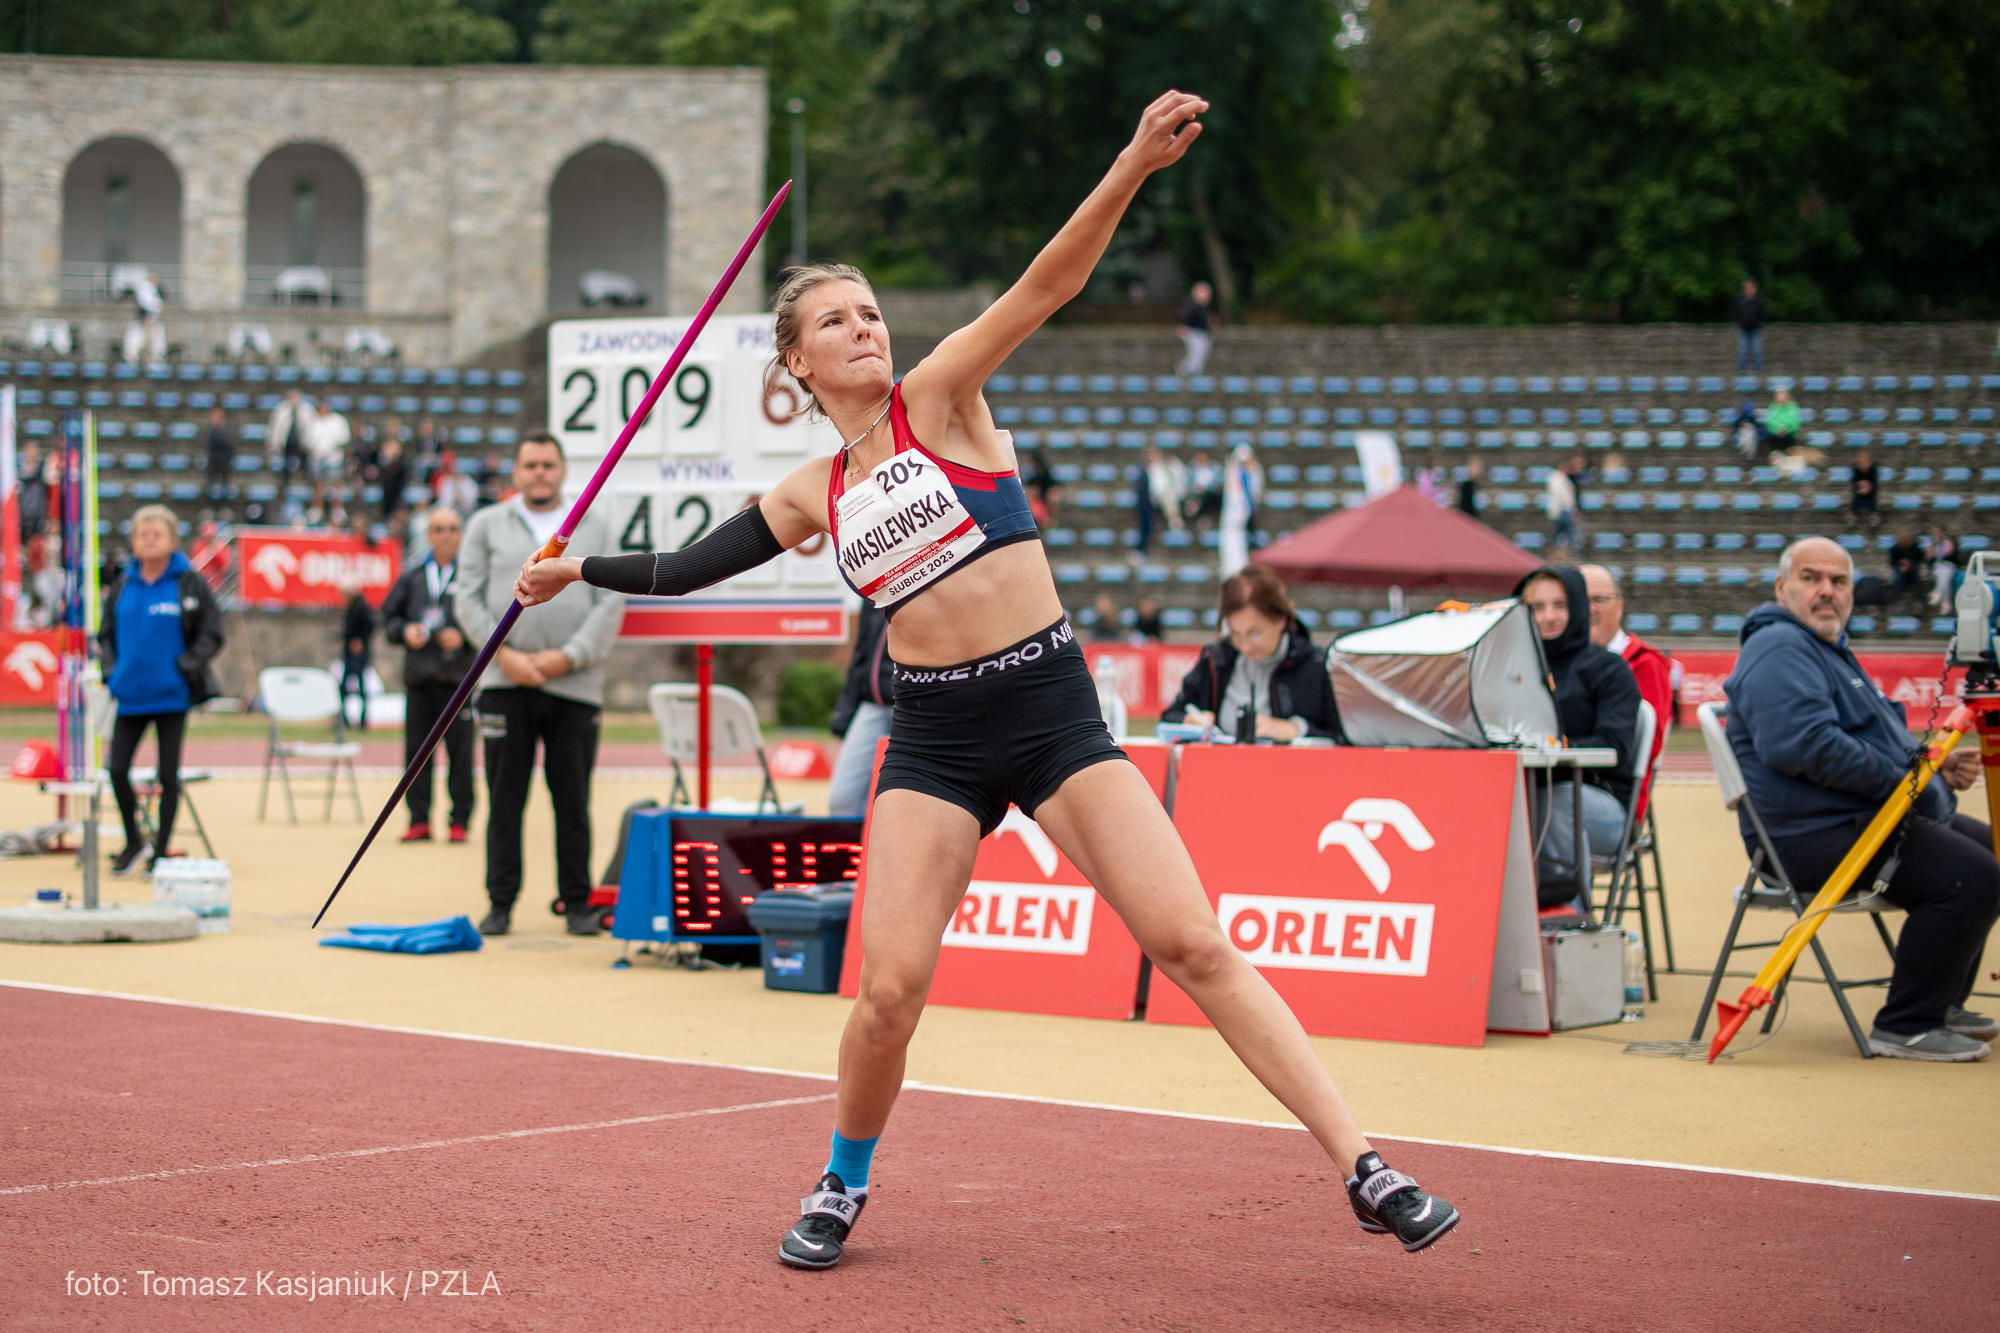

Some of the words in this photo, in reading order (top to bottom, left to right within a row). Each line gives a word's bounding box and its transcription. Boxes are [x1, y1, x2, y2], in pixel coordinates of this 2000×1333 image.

[563, 365, 712, 431] 209
[658, 461, 735, 481] WYNIK
[842, 490, 954, 572] WASILEWSKA
[889, 568, 928, 596] SŁUBICE
[927, 550, 955, 573] 2023
[901, 666, 972, 684] NIKE
[976, 642, 1043, 677] PRO
[953, 893, 1078, 941] RLEN
[1229, 908, 1417, 962] ORLEN
[817, 1196, 853, 1215] NIKE
[1367, 1172, 1399, 1201] NIKE
